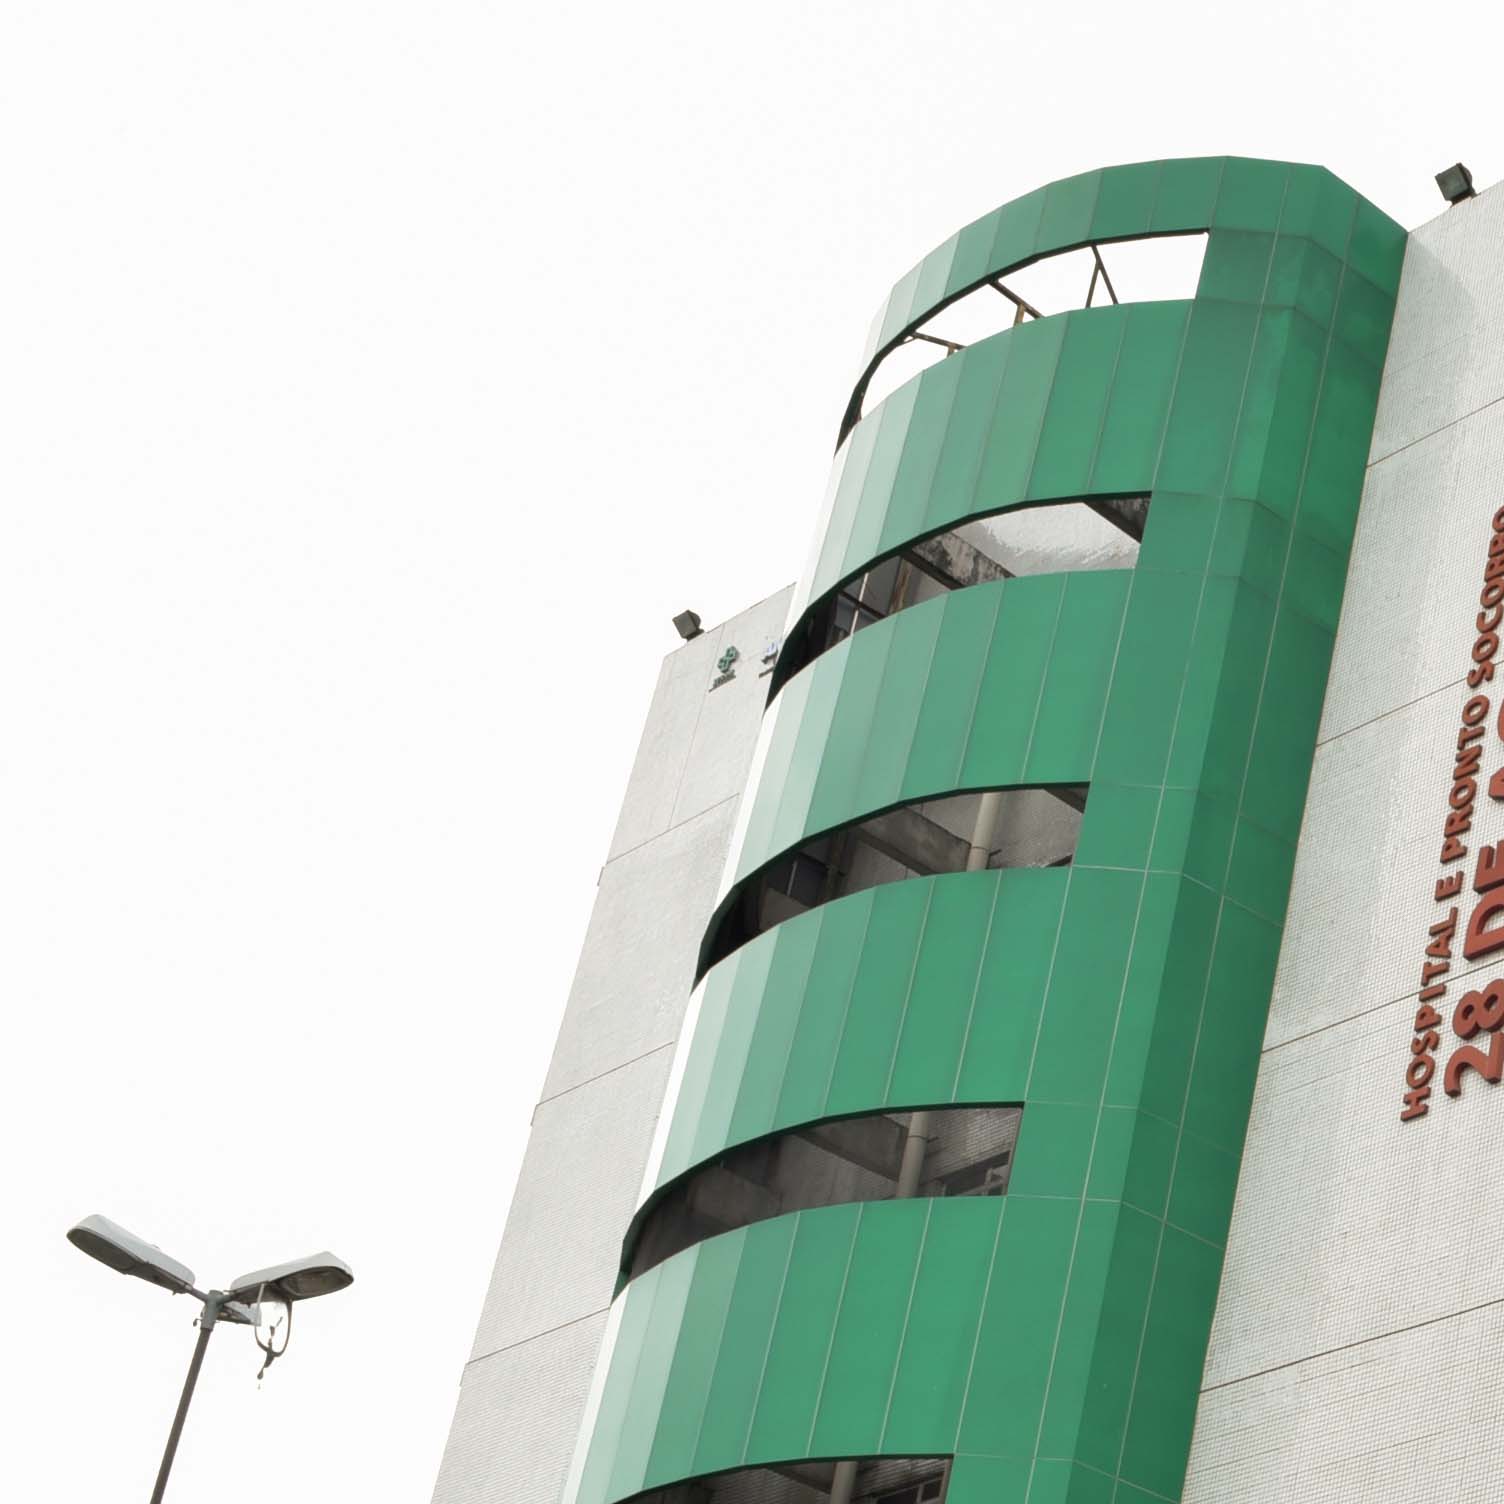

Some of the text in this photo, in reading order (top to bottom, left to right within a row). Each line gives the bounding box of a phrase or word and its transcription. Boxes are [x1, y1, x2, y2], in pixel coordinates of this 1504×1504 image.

[1440, 695, 1490, 864] PRONTO
[1435, 871, 1464, 901] E
[1400, 907, 1458, 1121] HOSPITAL
